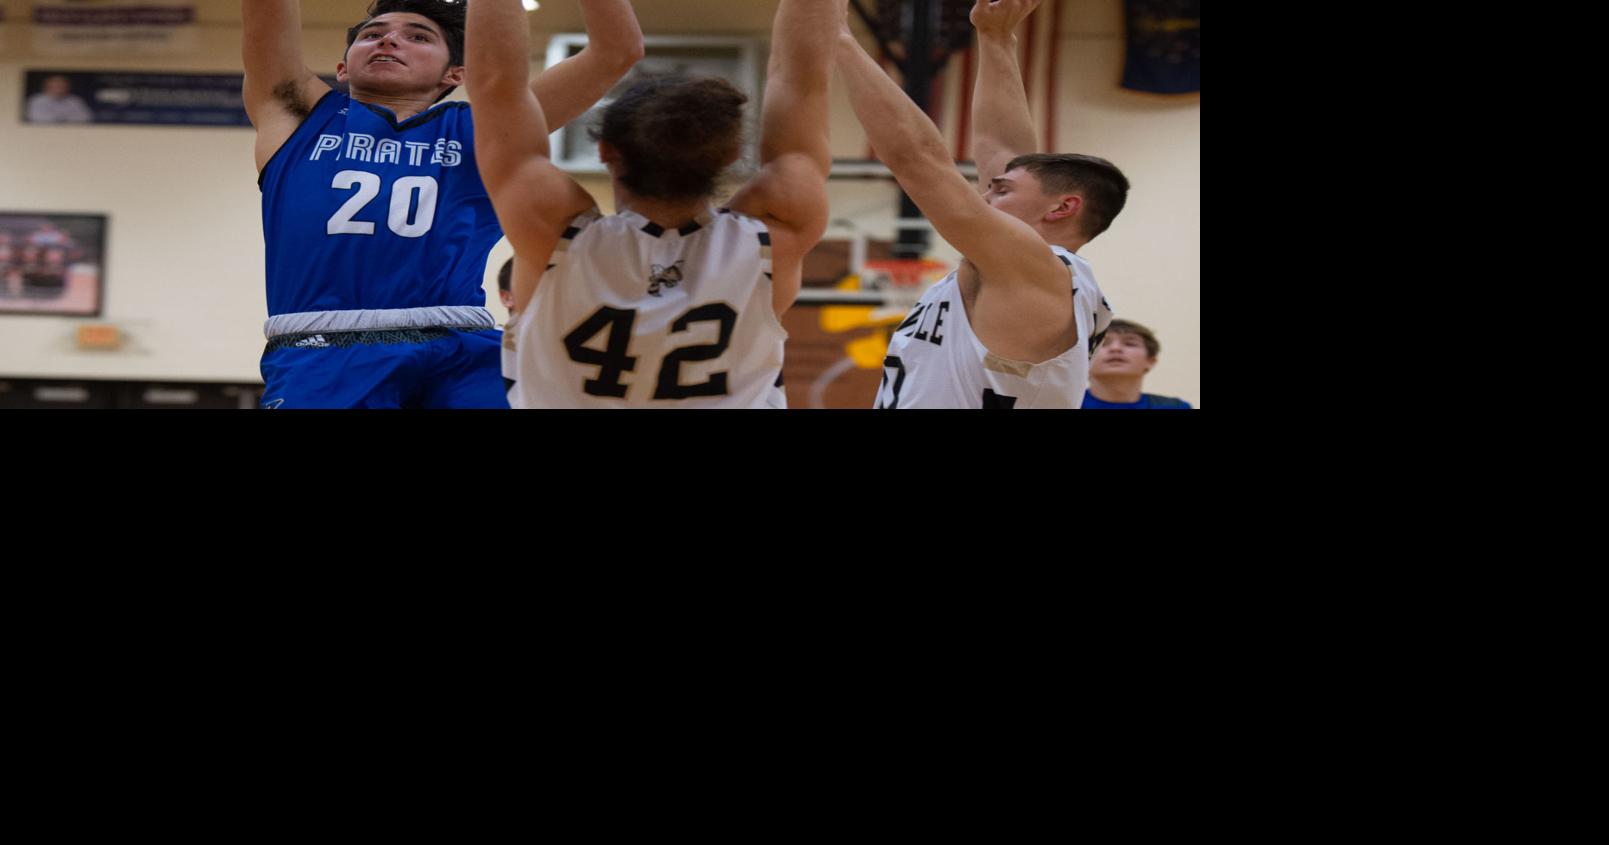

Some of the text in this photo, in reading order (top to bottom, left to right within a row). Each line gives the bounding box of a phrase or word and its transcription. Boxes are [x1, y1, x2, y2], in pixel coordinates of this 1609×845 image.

[309, 133, 462, 166] PRATES
[326, 169, 439, 238] 20
[563, 302, 739, 400] 42
